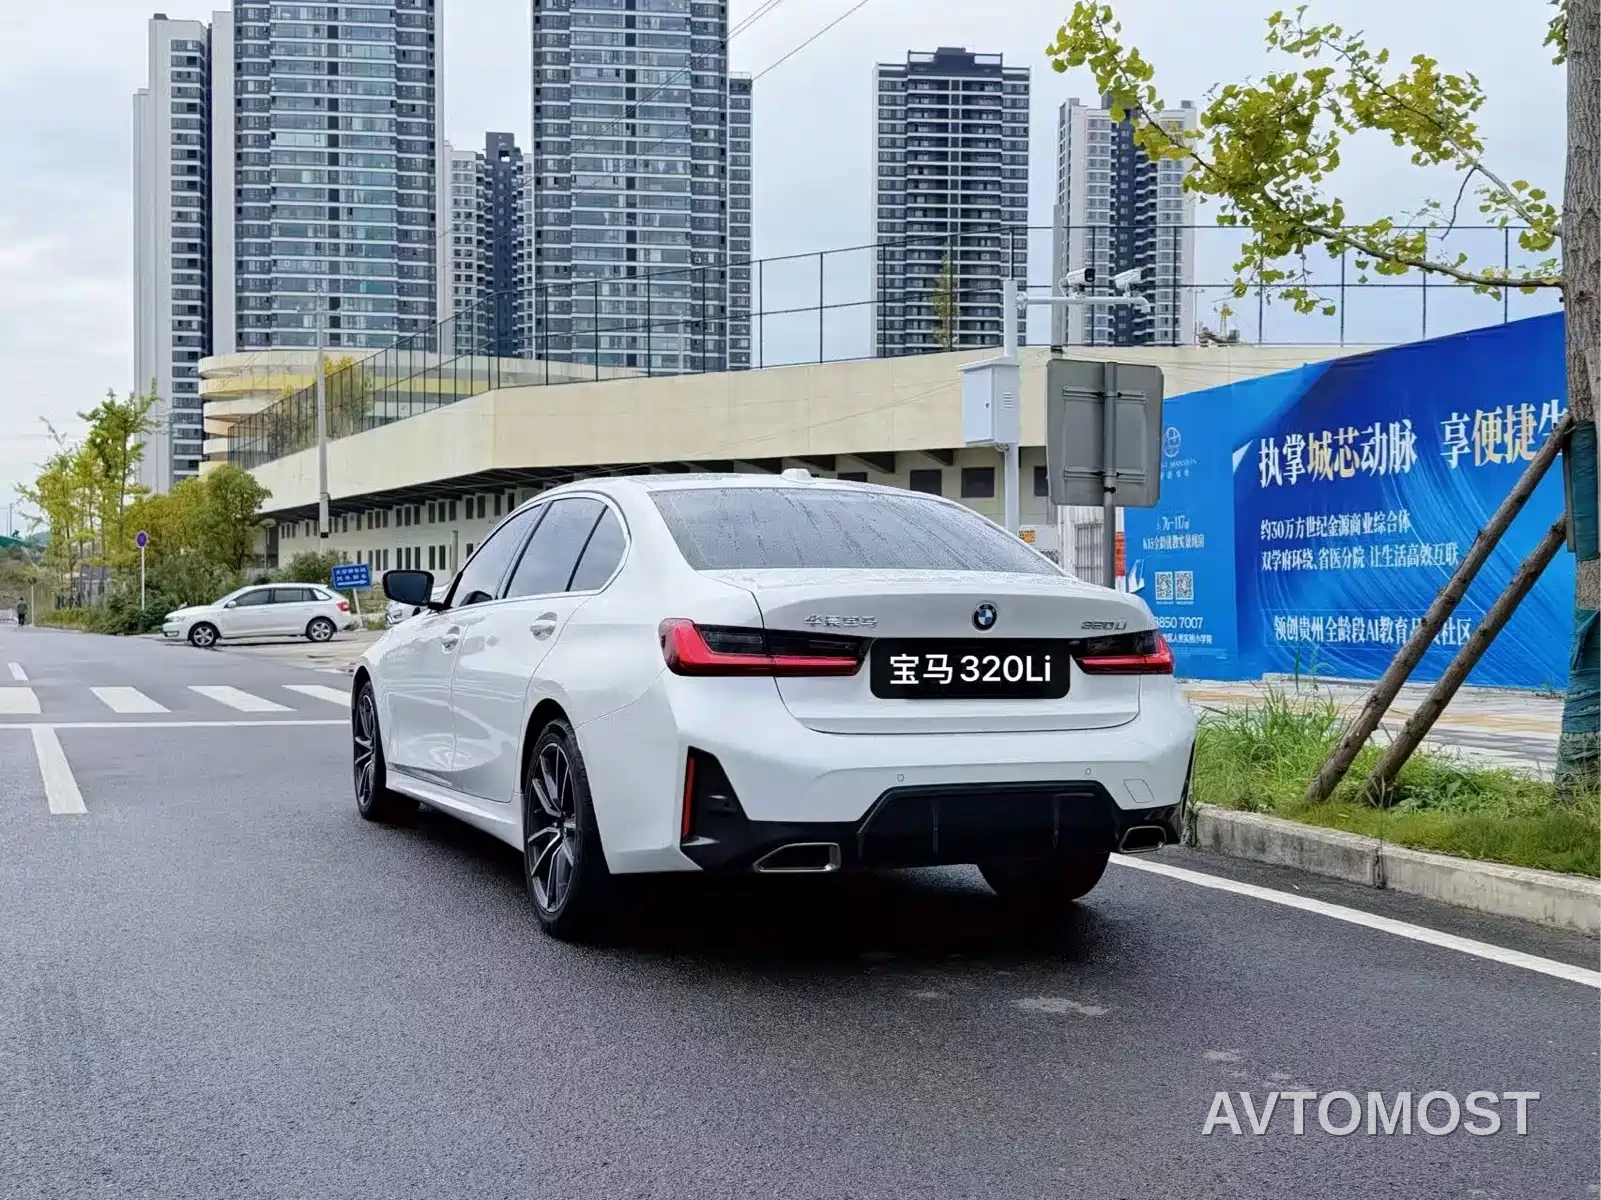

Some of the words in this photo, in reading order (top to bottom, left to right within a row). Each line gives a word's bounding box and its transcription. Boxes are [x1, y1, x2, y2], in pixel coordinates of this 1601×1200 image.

[1259, 418, 1418, 488] 执掌城芯动脉
[1260, 509, 1411, 541] 约30万方世纪金源商业综合体
[1261, 548, 1365, 572] 双学府环绕、省医分院
[1370, 541, 1459, 569] 让生活高效互联
[1178, 616, 1203, 629] 7007
[1273, 615, 1471, 646] 领创贵州全龄段AI教育社区
